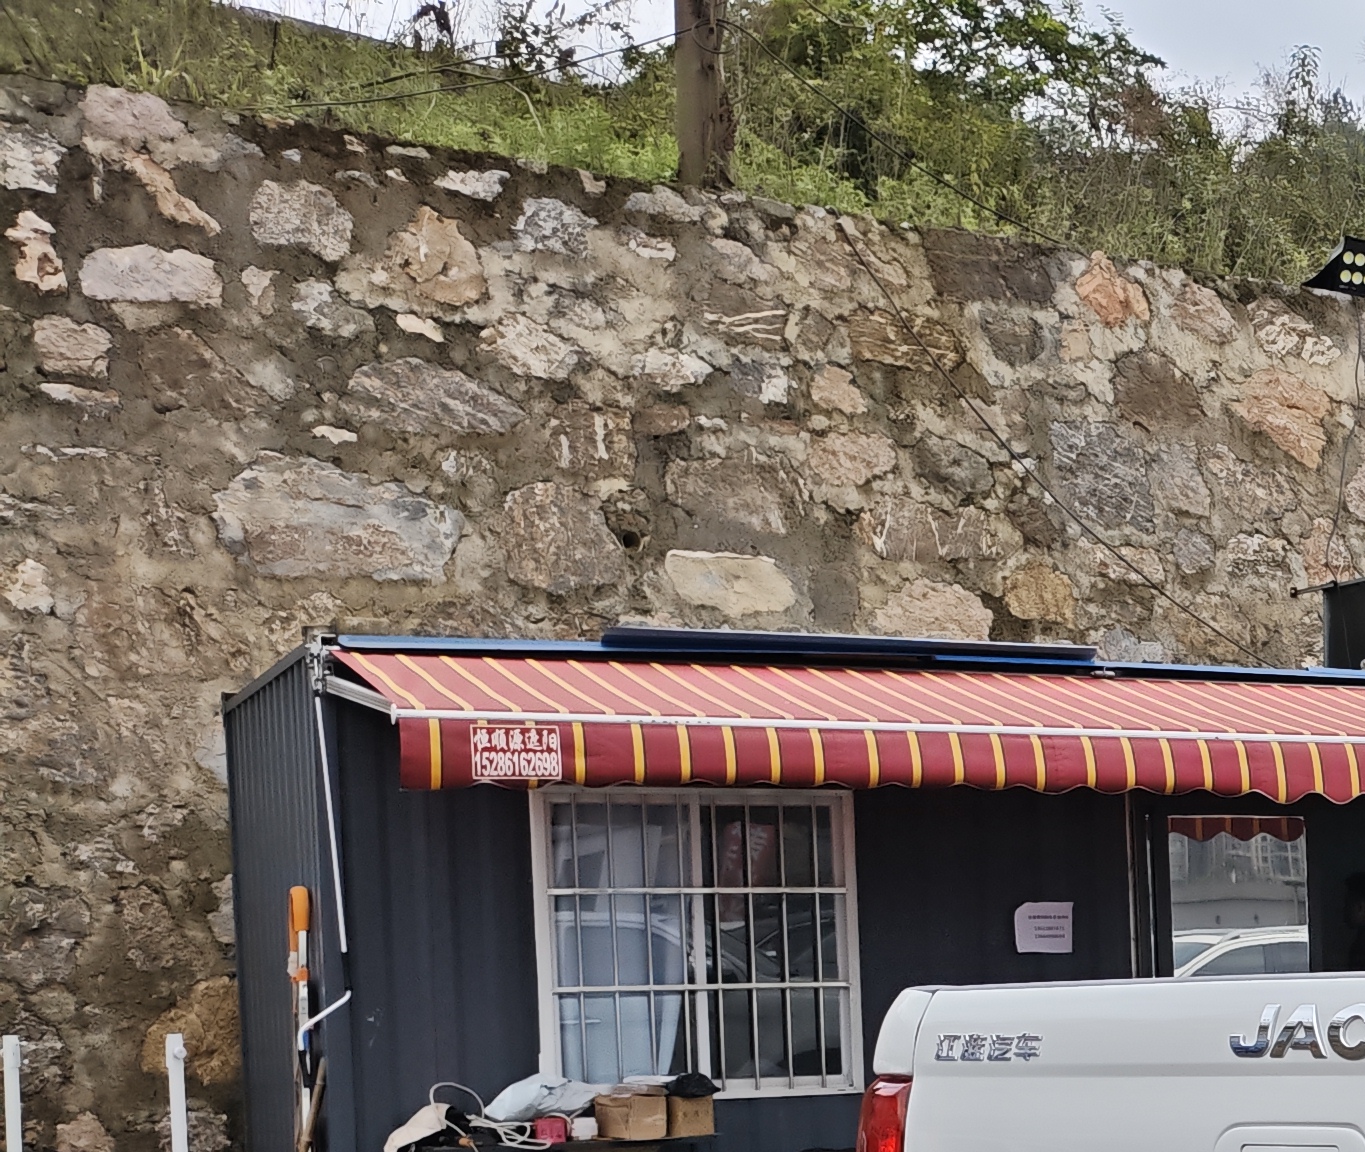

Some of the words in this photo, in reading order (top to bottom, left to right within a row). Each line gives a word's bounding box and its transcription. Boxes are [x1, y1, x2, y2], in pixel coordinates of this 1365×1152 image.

[474, 751, 558, 776] 15286162698
[934, 1033, 1044, 1062] 江淮汽车
